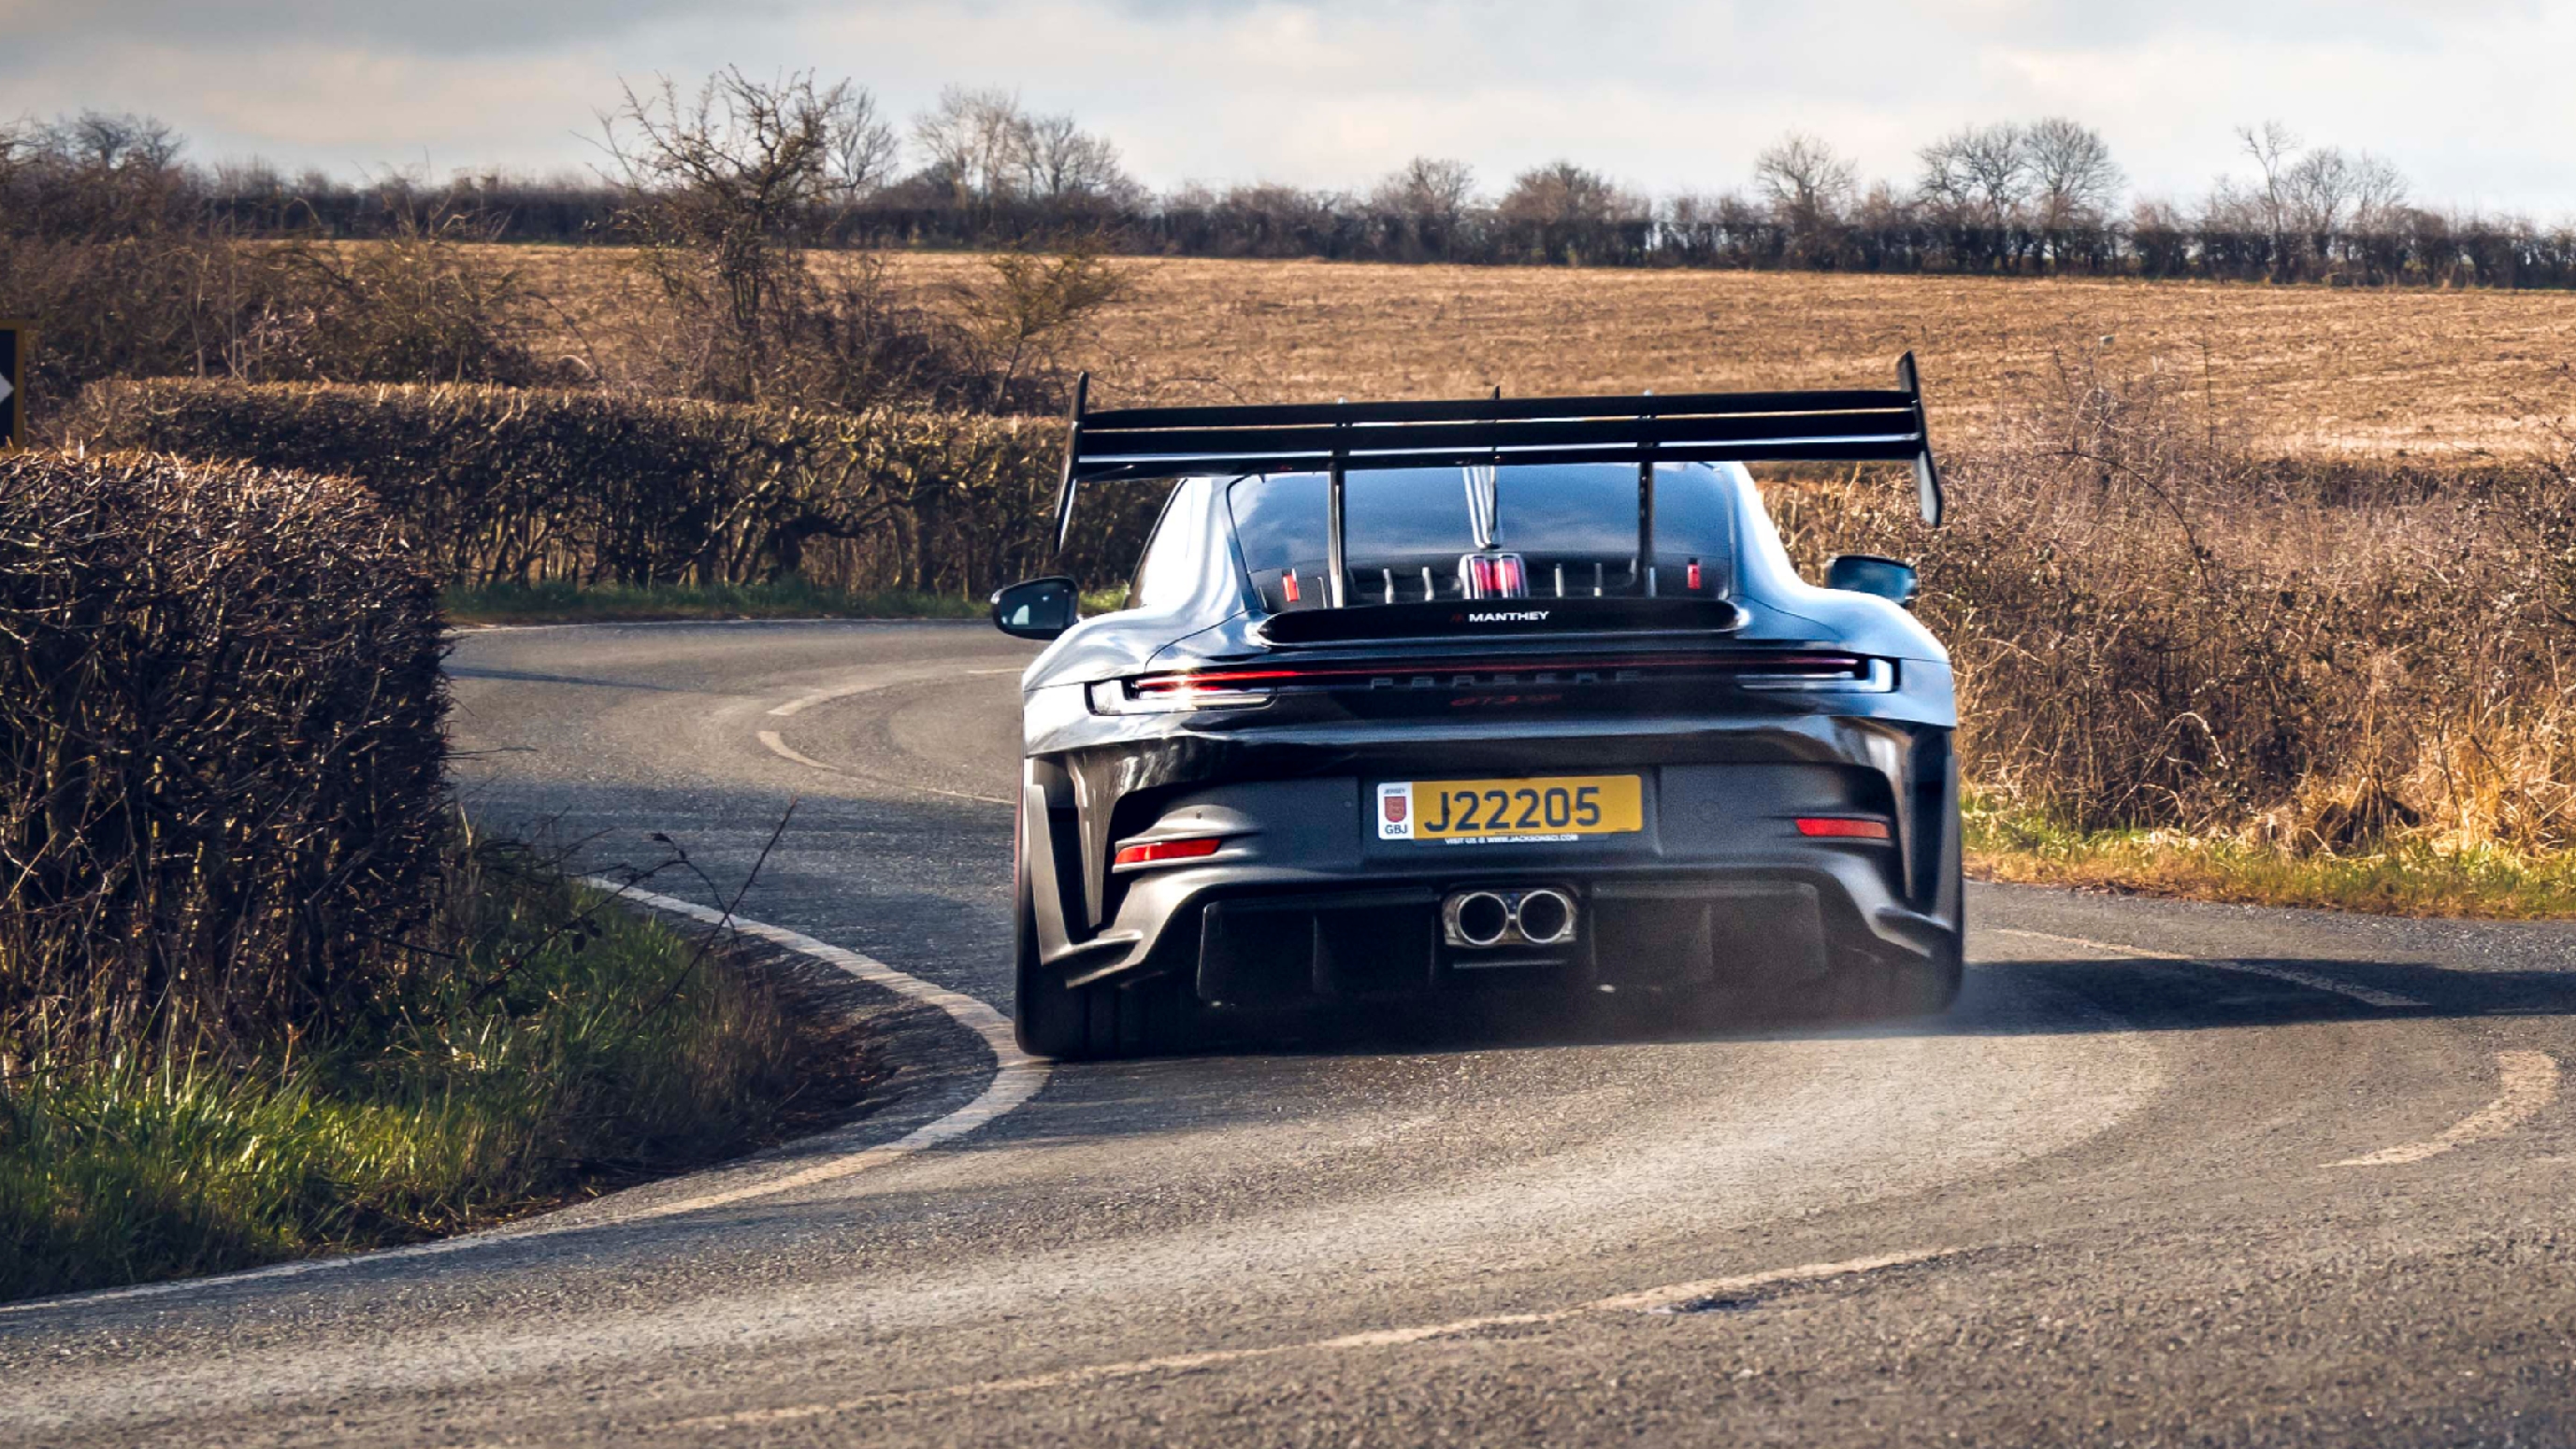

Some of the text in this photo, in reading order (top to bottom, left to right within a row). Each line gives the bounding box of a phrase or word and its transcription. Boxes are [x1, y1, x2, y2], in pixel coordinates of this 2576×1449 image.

[1468, 610, 1549, 623] MANTHEY
[1424, 786, 1600, 832] J22205
[1384, 824, 1408, 835] GBJ
